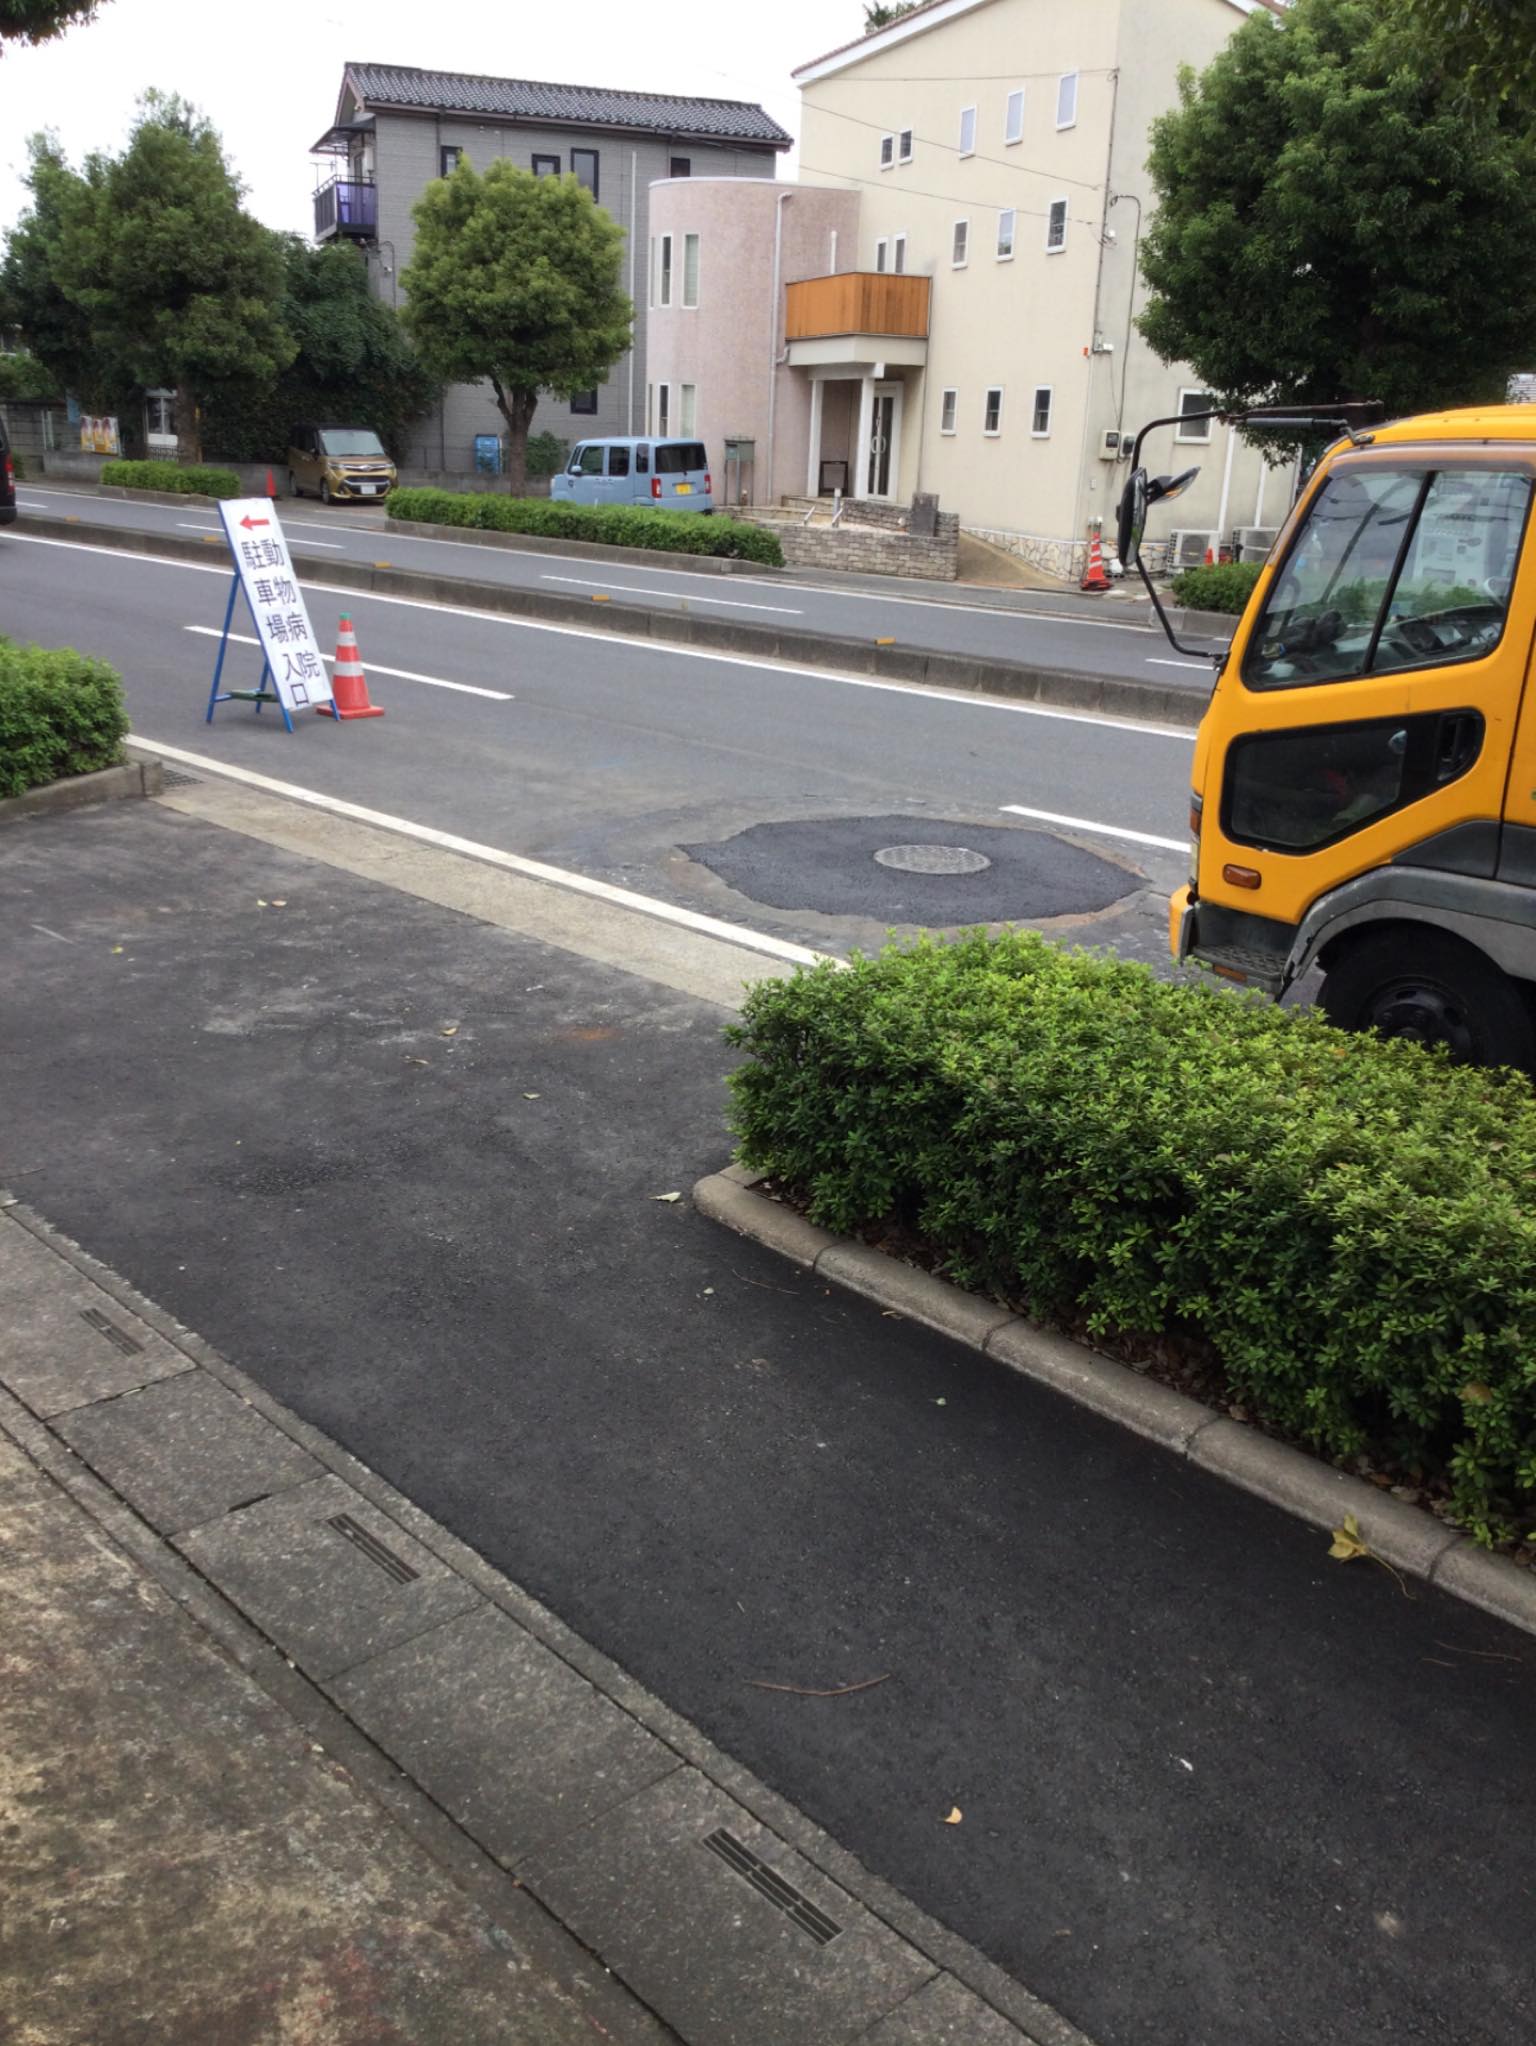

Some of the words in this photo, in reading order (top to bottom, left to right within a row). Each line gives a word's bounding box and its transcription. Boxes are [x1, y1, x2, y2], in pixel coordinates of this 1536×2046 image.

[241, 541, 309, 706] 駐車場入口
[261, 538, 320, 680] 動物病院
